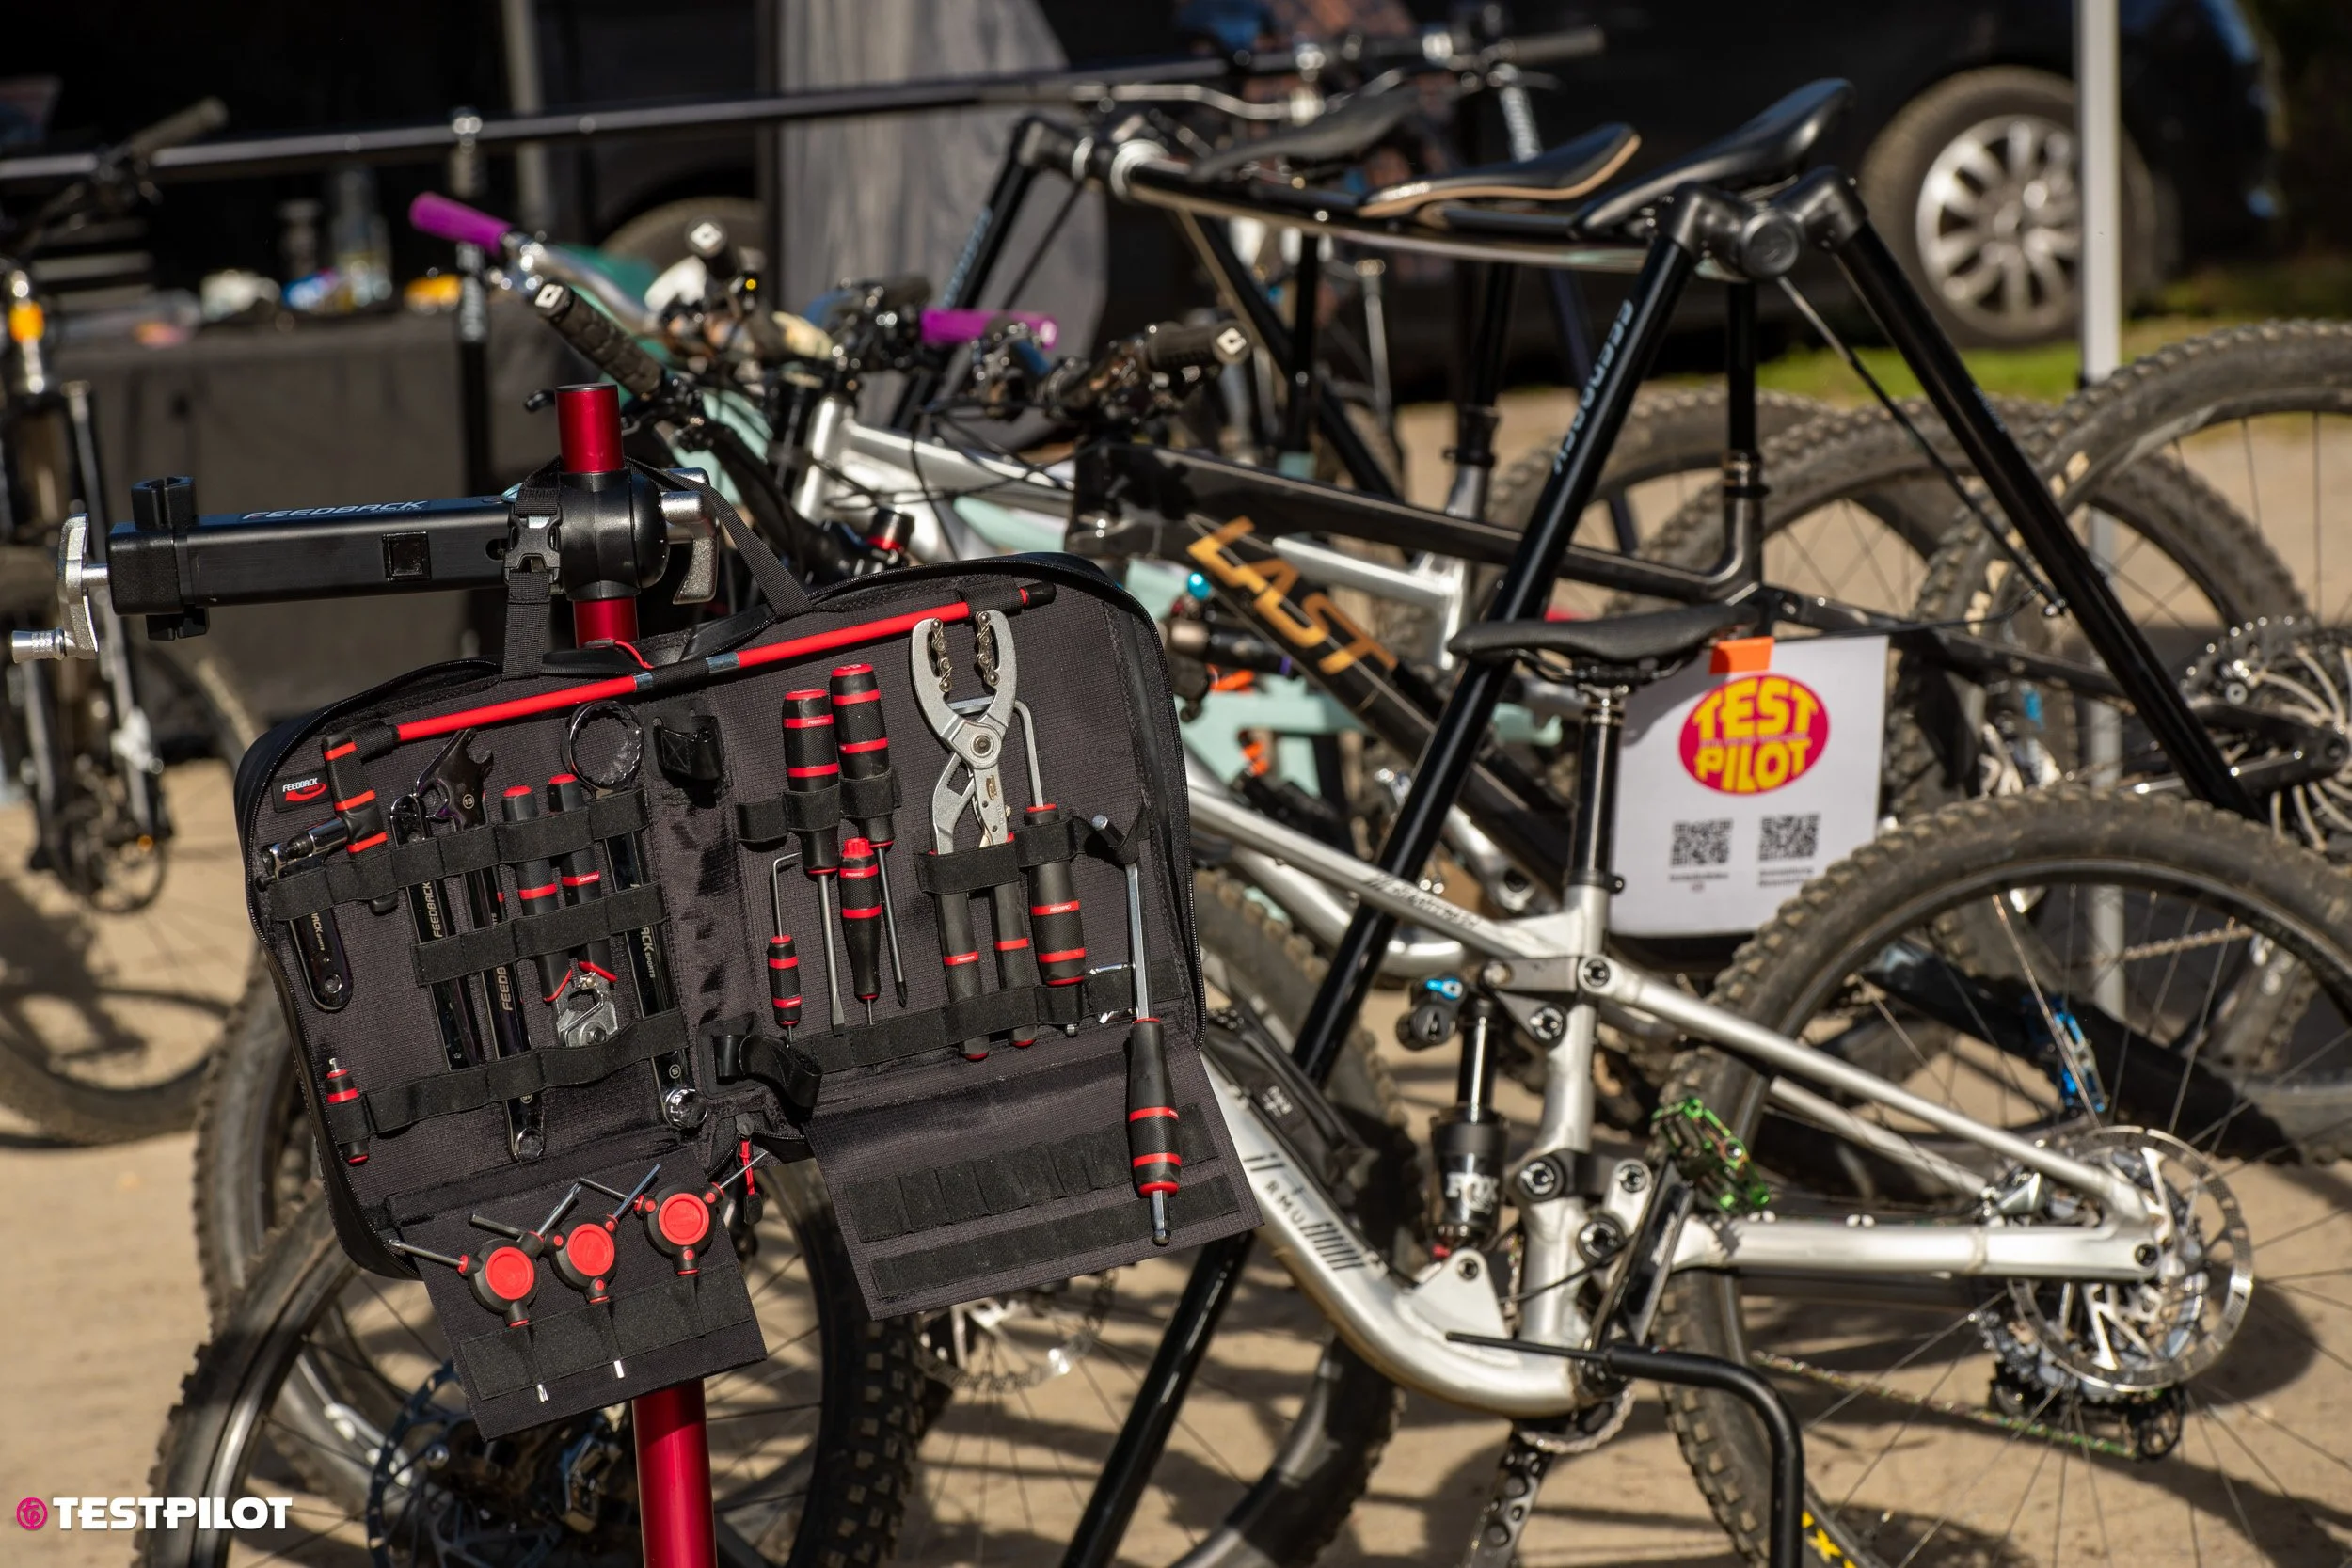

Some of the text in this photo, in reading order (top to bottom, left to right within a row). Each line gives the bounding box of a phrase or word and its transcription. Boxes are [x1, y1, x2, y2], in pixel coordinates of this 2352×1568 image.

[242, 500, 427, 519] FEEDBACK
[1692, 676, 1820, 740] TEST
[282, 778, 318, 793] FEEDBACK
[1693, 738, 1812, 794] PILOT
[422, 881, 444, 939] FEEDBACK
[640, 927, 656, 978] ACK SPORTS
[496, 966, 514, 1011] FEEDB
[1445, 1171, 1500, 1216] FOX
